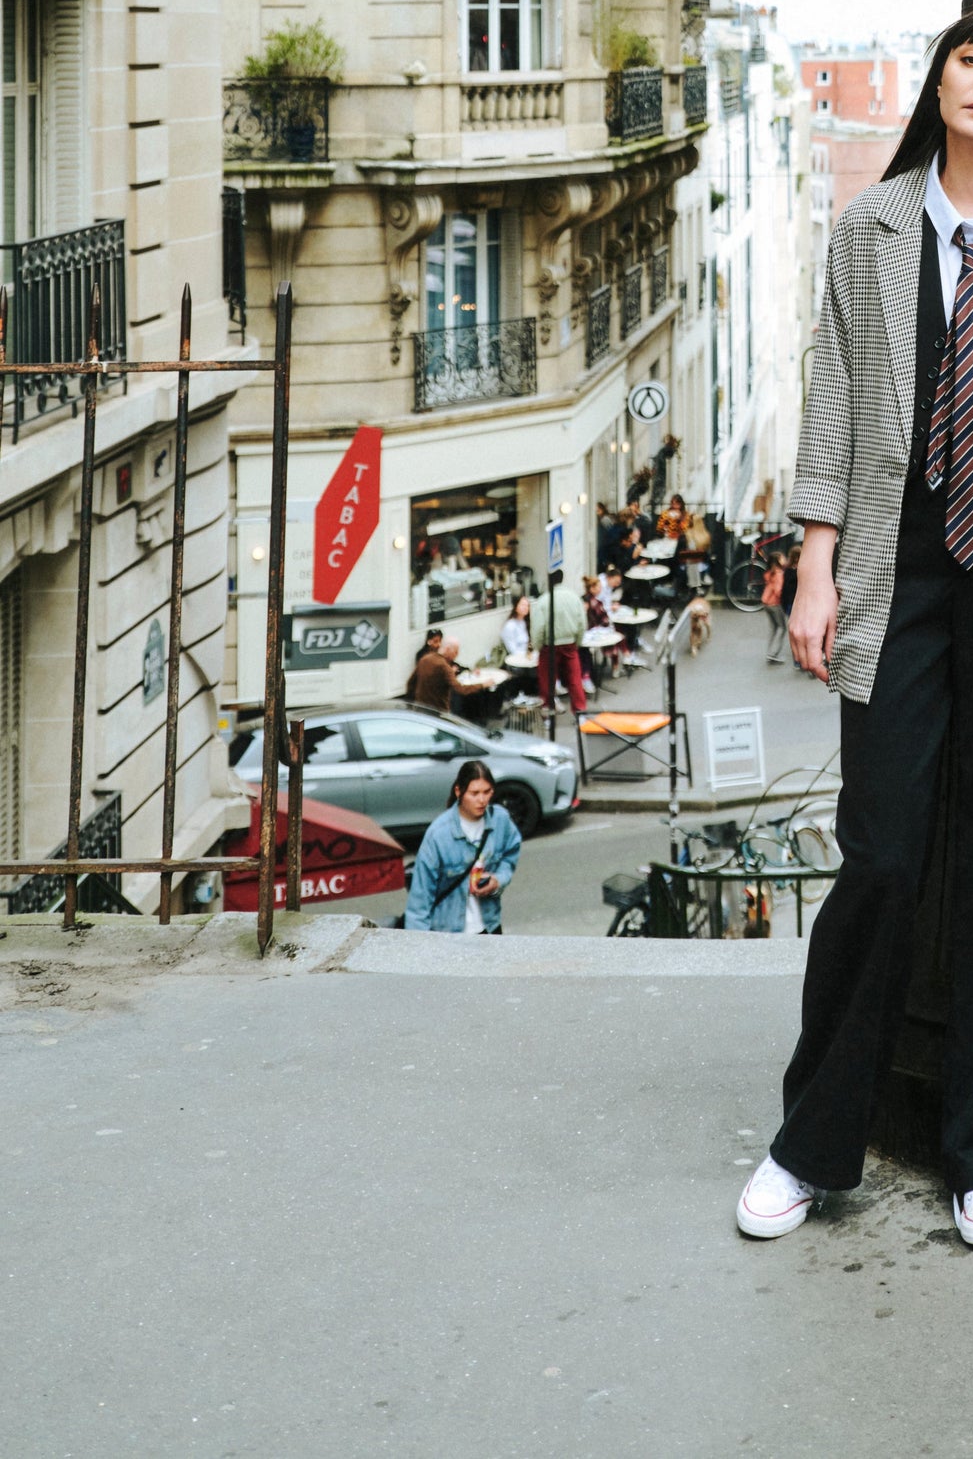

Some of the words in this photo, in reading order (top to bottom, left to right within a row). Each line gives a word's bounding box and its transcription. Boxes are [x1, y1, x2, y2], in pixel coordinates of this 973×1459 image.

[327, 463, 368, 568] TABAC
[305, 628, 345, 649] FDJ
[273, 874, 347, 903] TBAC
